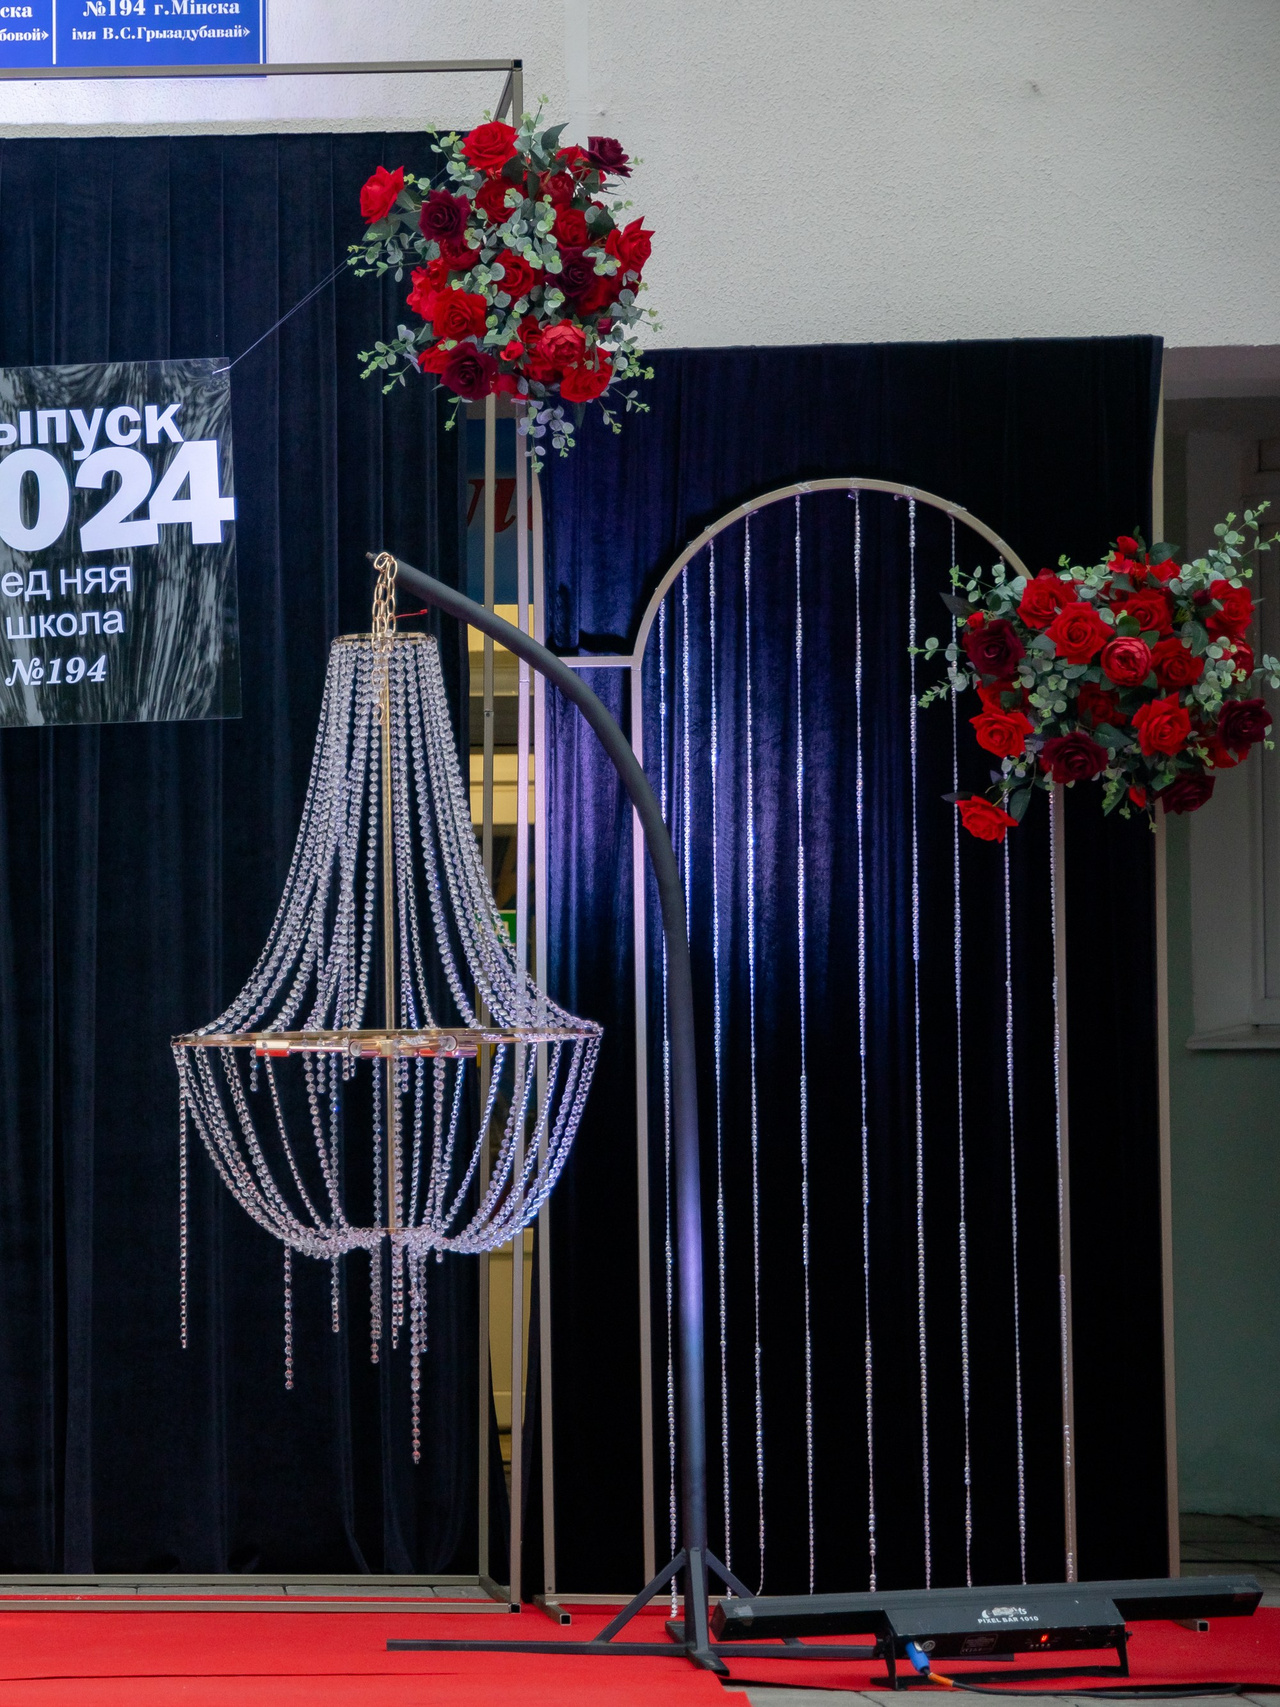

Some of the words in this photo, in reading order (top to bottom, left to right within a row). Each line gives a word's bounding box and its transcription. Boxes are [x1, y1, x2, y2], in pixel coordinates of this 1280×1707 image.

[82, 0, 146, 17] №194
[71, 28, 97, 41] імя
[5, 610, 124, 640] школа
[4, 655, 107, 687] №194
